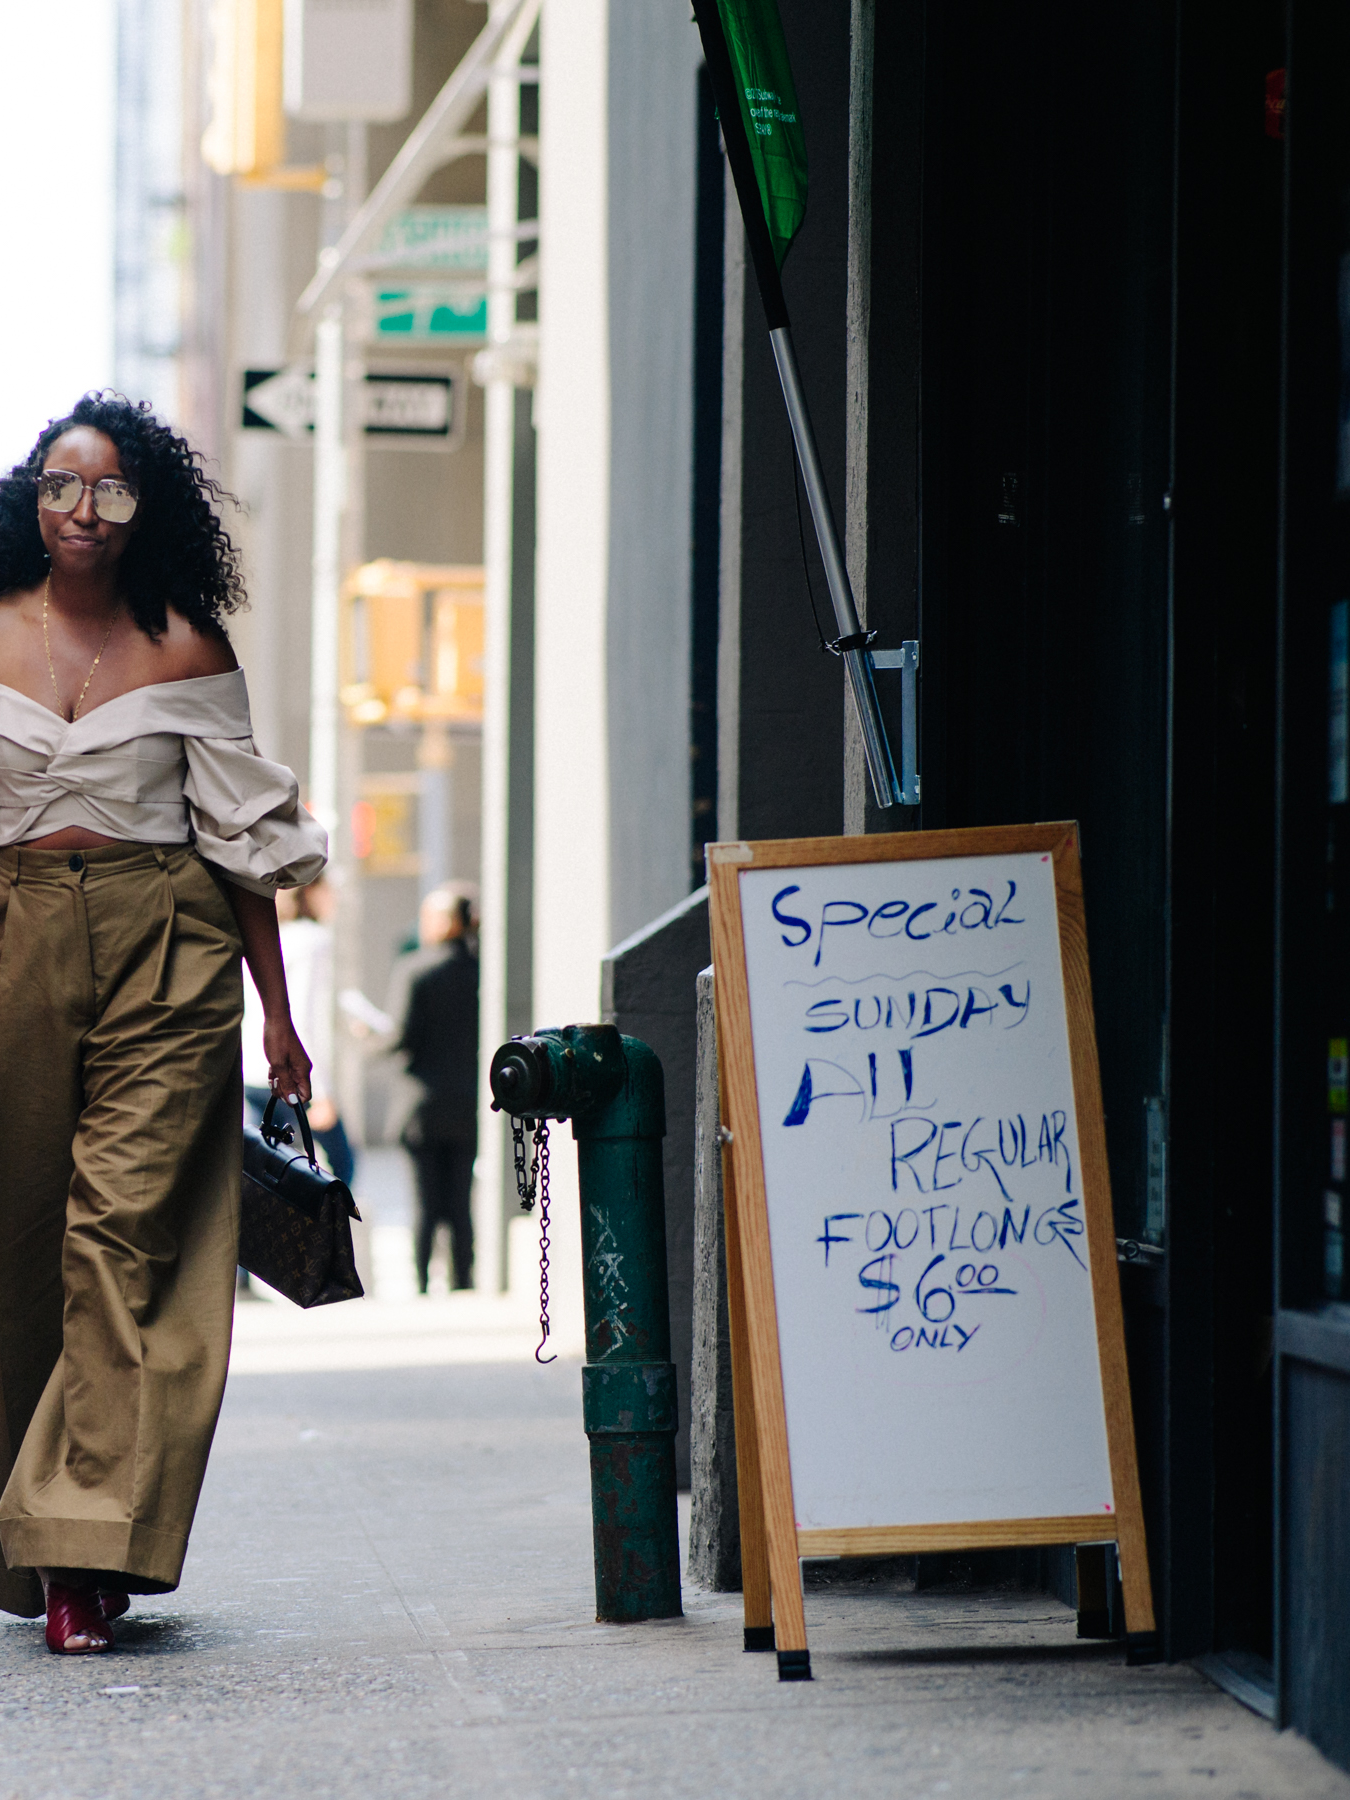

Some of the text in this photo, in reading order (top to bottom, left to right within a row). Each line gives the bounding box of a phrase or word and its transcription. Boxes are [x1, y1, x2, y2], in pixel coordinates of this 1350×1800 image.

[803, 979, 1030, 1040] SUNDAY
[782, 1045, 938, 1127] ALL
[890, 1110, 1072, 1203] REGULAR
[815, 1199, 1088, 1272] FOOTLONGS
[890, 1324, 981, 1353] ONLY
